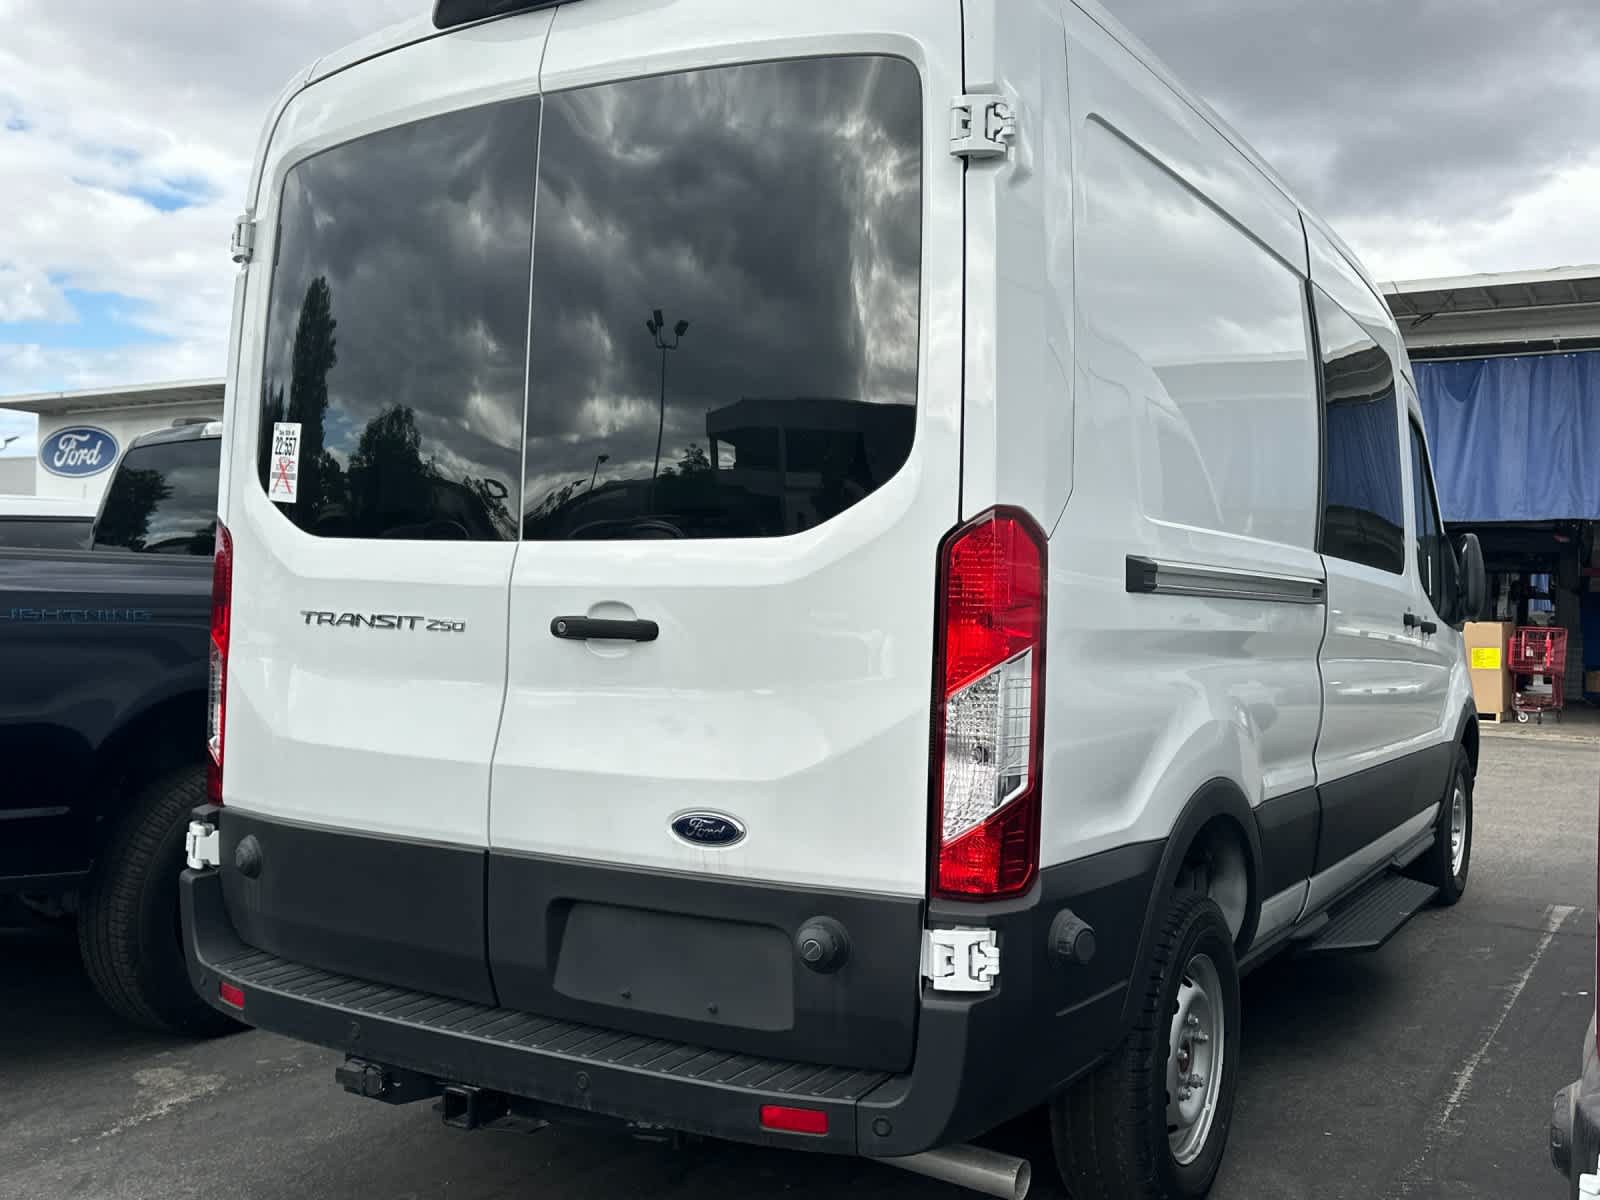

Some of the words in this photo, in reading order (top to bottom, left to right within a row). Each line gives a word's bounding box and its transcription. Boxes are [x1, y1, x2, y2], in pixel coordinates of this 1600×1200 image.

[54, 433, 102, 467] Ford
[300, 610, 425, 631] TRANSIT
[426, 618, 466, 633] 250
[686, 817, 726, 838] Ford
